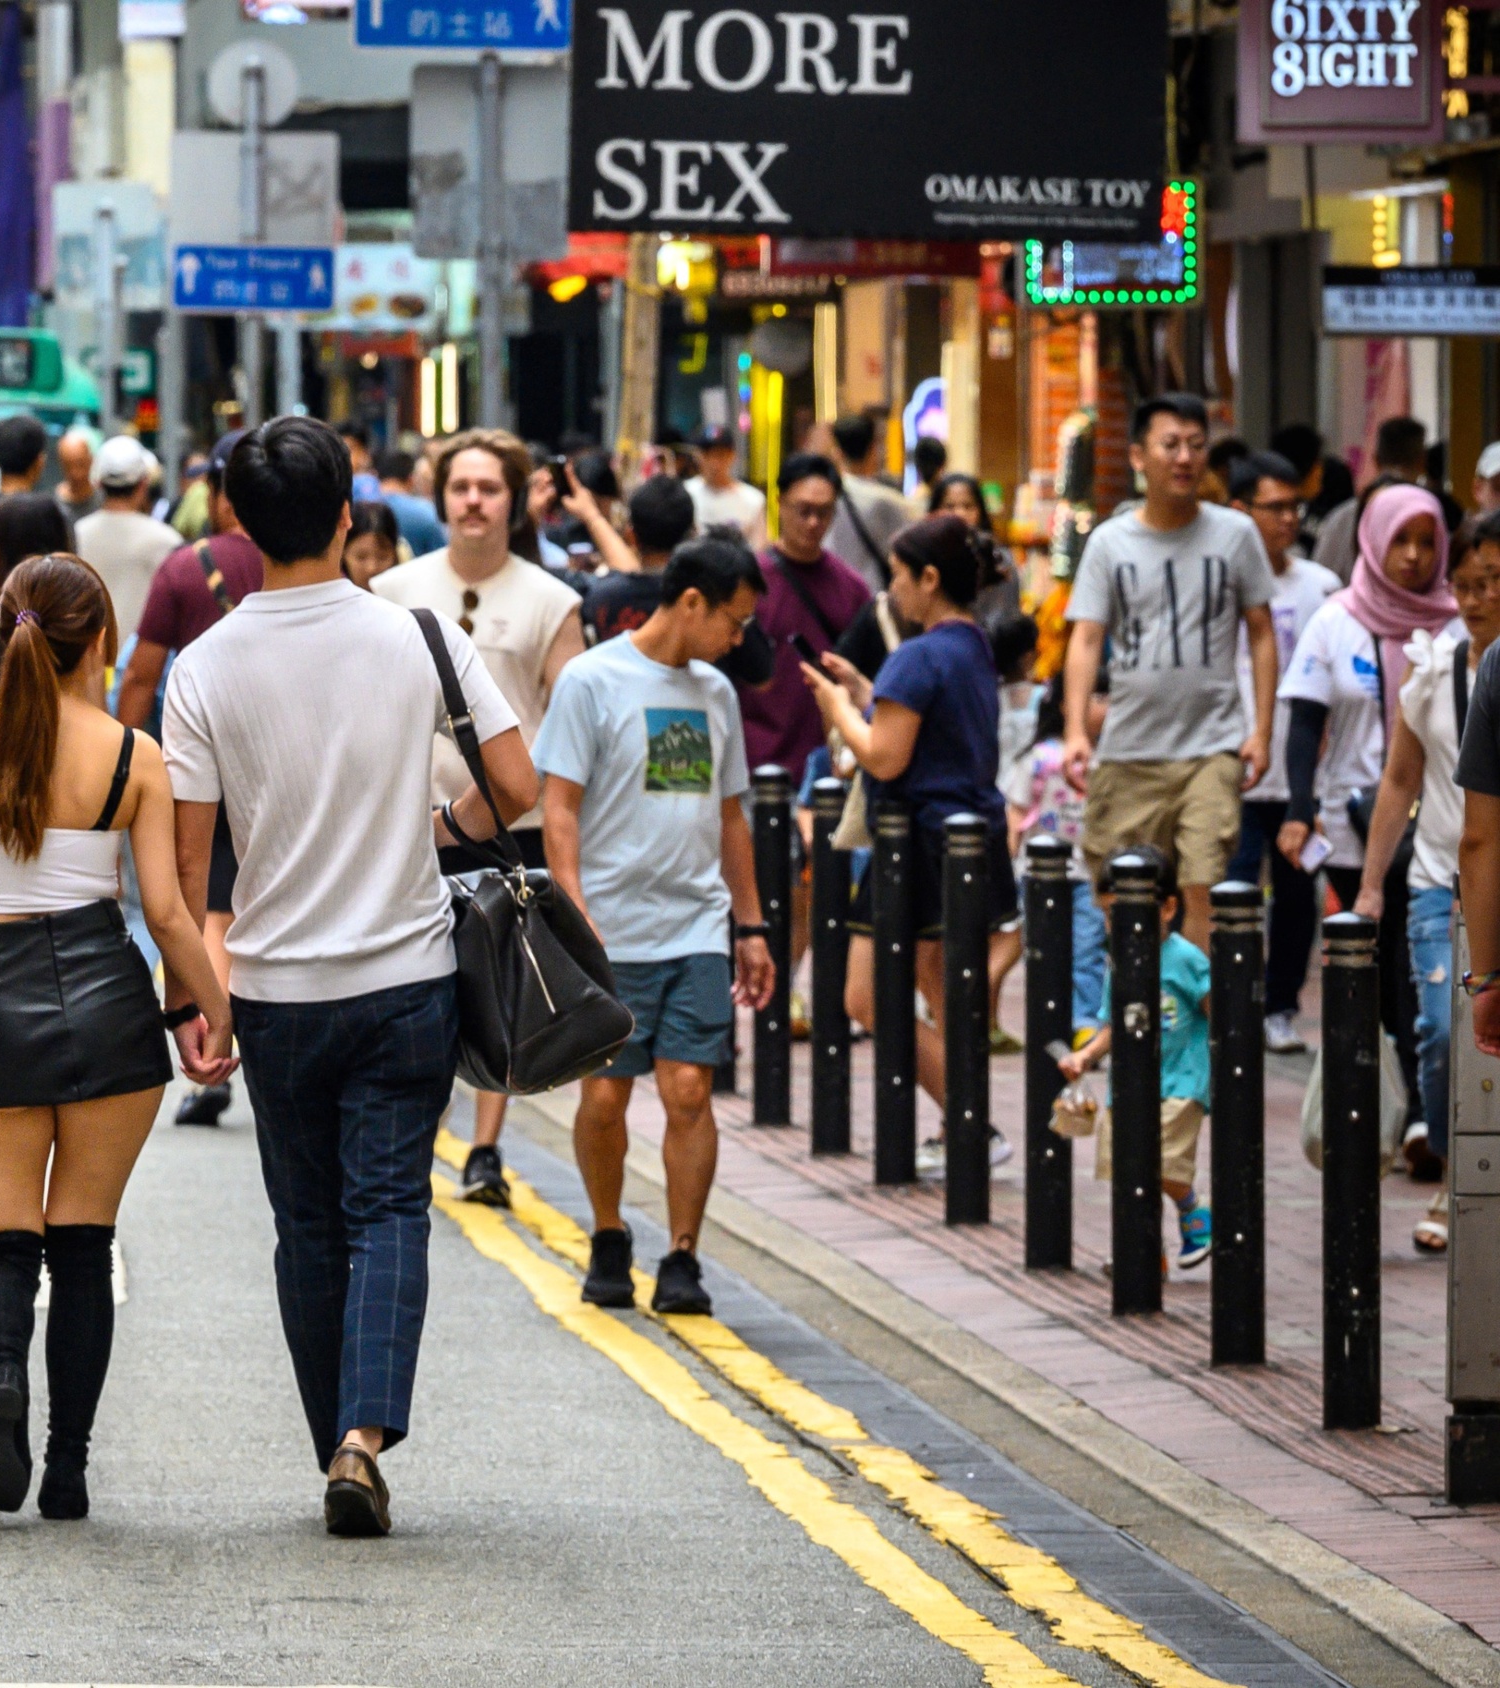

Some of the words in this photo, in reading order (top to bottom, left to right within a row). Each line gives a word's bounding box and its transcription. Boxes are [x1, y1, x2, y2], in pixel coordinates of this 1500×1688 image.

[596, 9, 913, 95] MORE
[1271, 41, 1419, 97] 8IGHT
[592, 138, 792, 223] SEX
[924, 173, 1080, 205] OMAKASE
[1085, 179, 1150, 208] TOY
[1113, 556, 1228, 669] GAP
